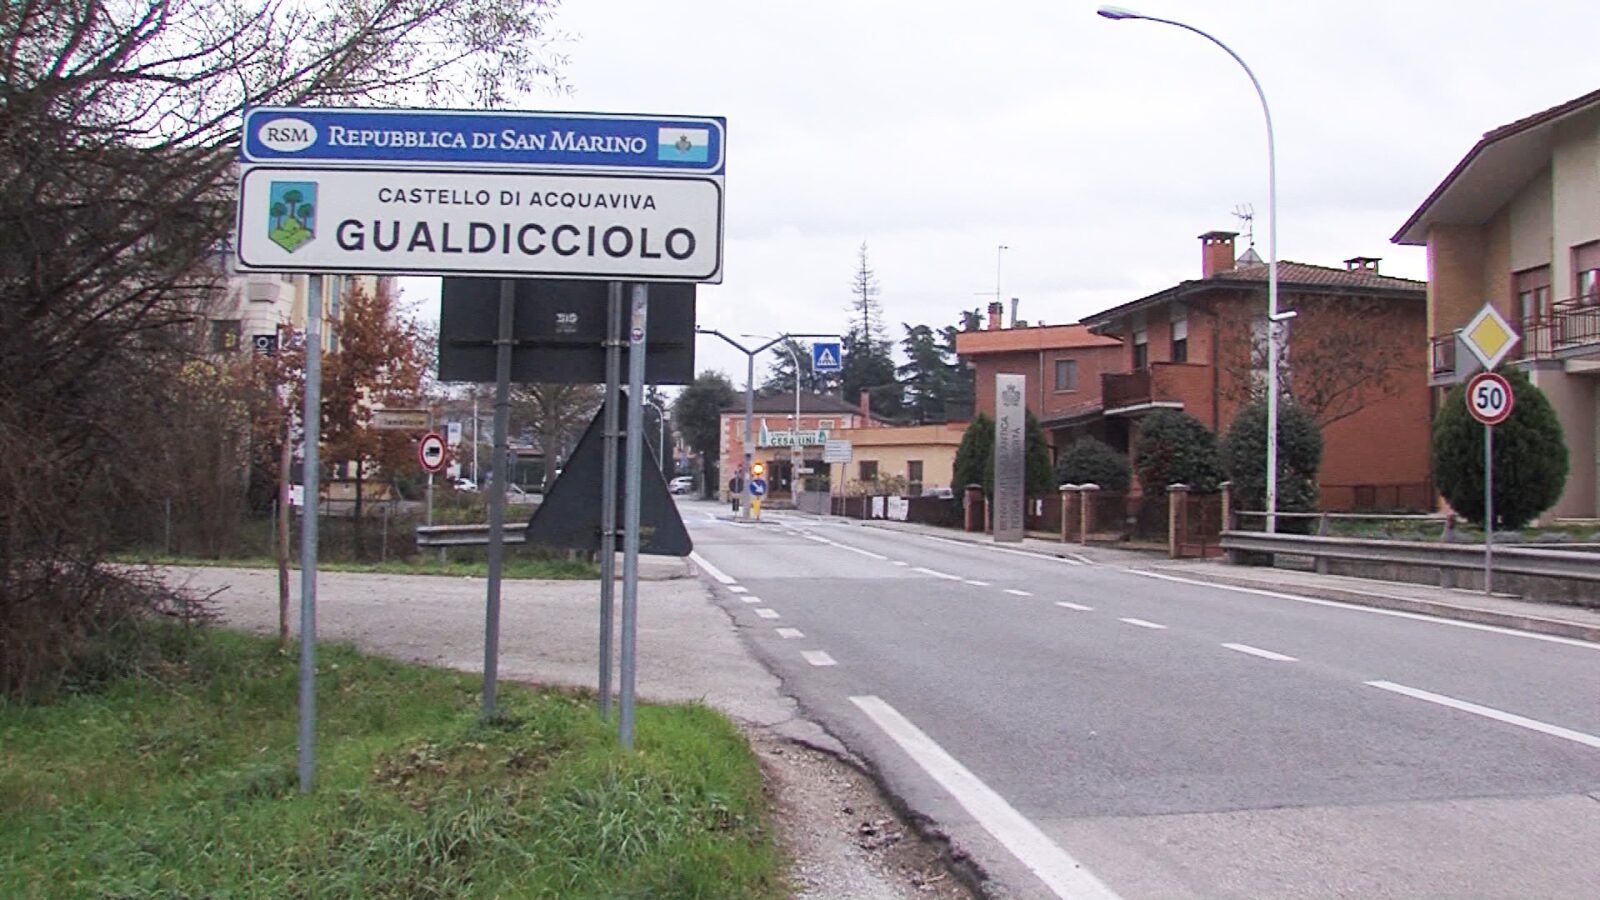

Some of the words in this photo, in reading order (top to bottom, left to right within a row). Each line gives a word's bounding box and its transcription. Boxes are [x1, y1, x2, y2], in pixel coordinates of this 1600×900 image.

[267, 127, 309, 142] RSM
[328, 125, 467, 149] REPUBBLICA
[471, 132, 496, 150] DI
[501, 129, 547, 151] SAN
[549, 131, 647, 154] MARINO
[378, 187, 491, 206] CASTELLO
[500, 190, 520, 206] DI
[529, 191, 656, 210] ACQUAVIVA
[336, 218, 696, 261] GUALDICCIOLO
[1477, 386, 1502, 410] 50
